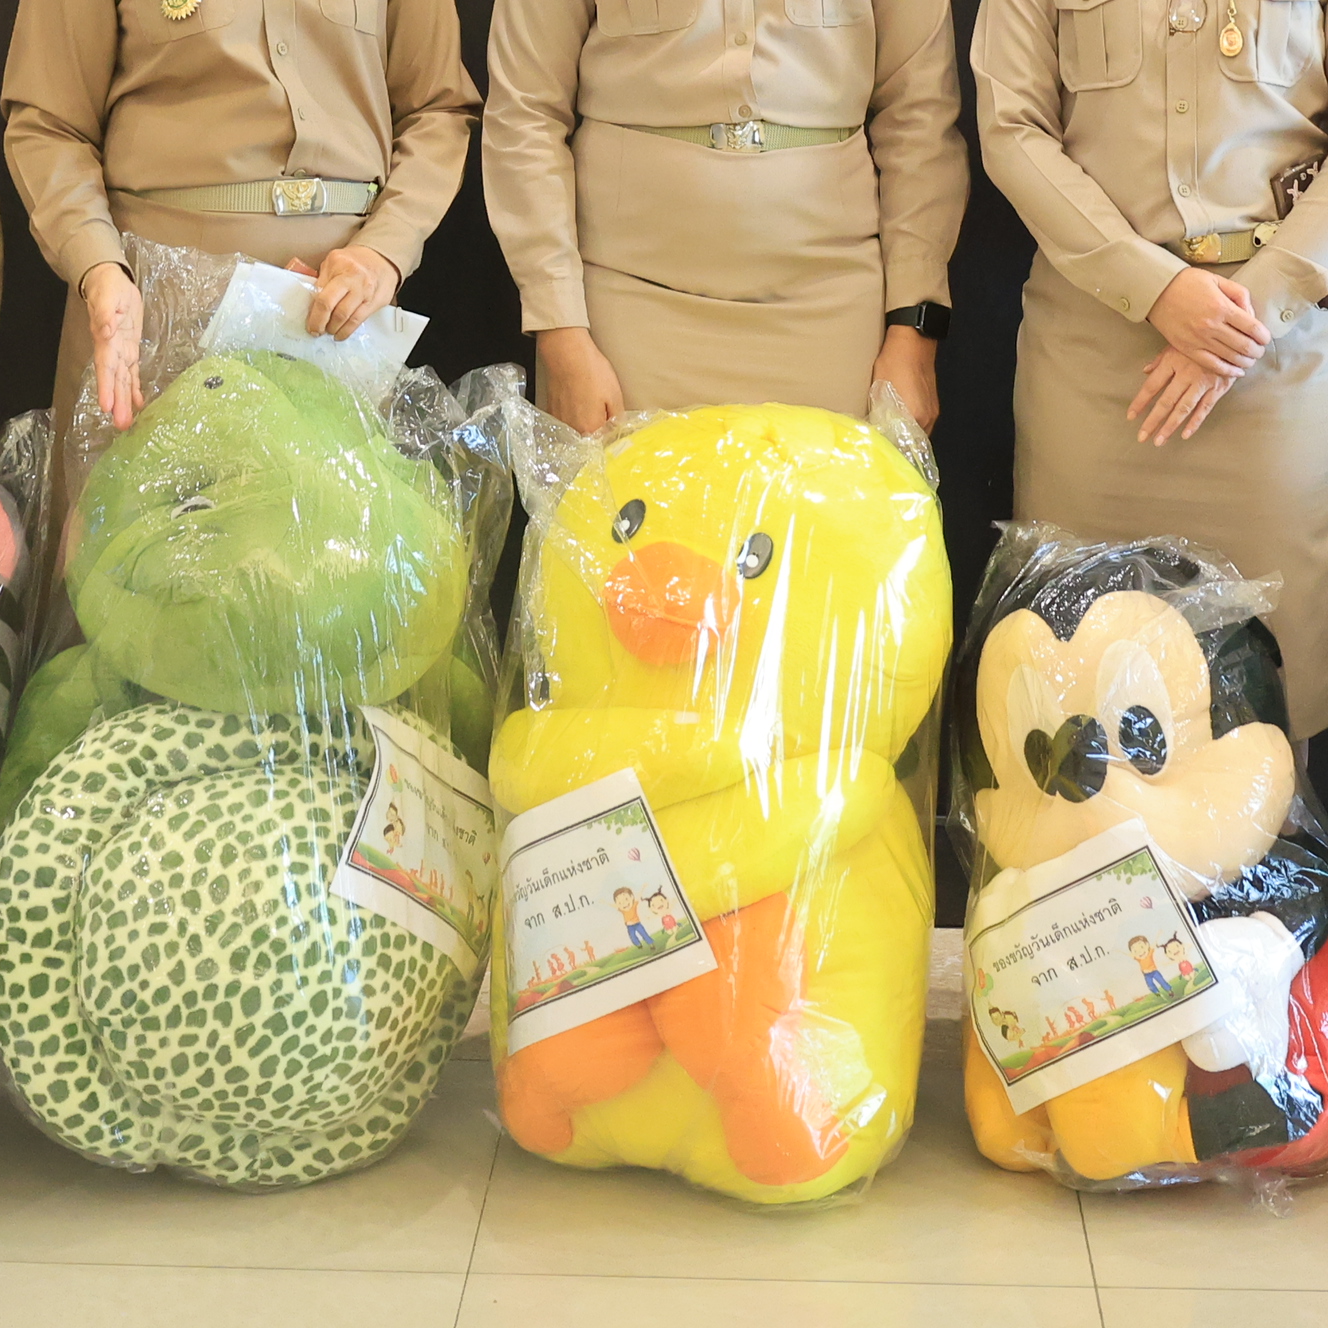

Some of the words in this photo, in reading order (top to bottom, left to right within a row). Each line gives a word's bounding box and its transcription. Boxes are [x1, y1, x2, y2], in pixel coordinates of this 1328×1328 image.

[524, 912, 545, 929] จาก
[552, 893, 594, 919] ส.ป.ก.
[992, 898, 1123, 973] ของขวัญวันเด็กแห่งชาติ
[1030, 966, 1058, 987] จาก
[1066, 944, 1110, 971] ส.ป.ก.
